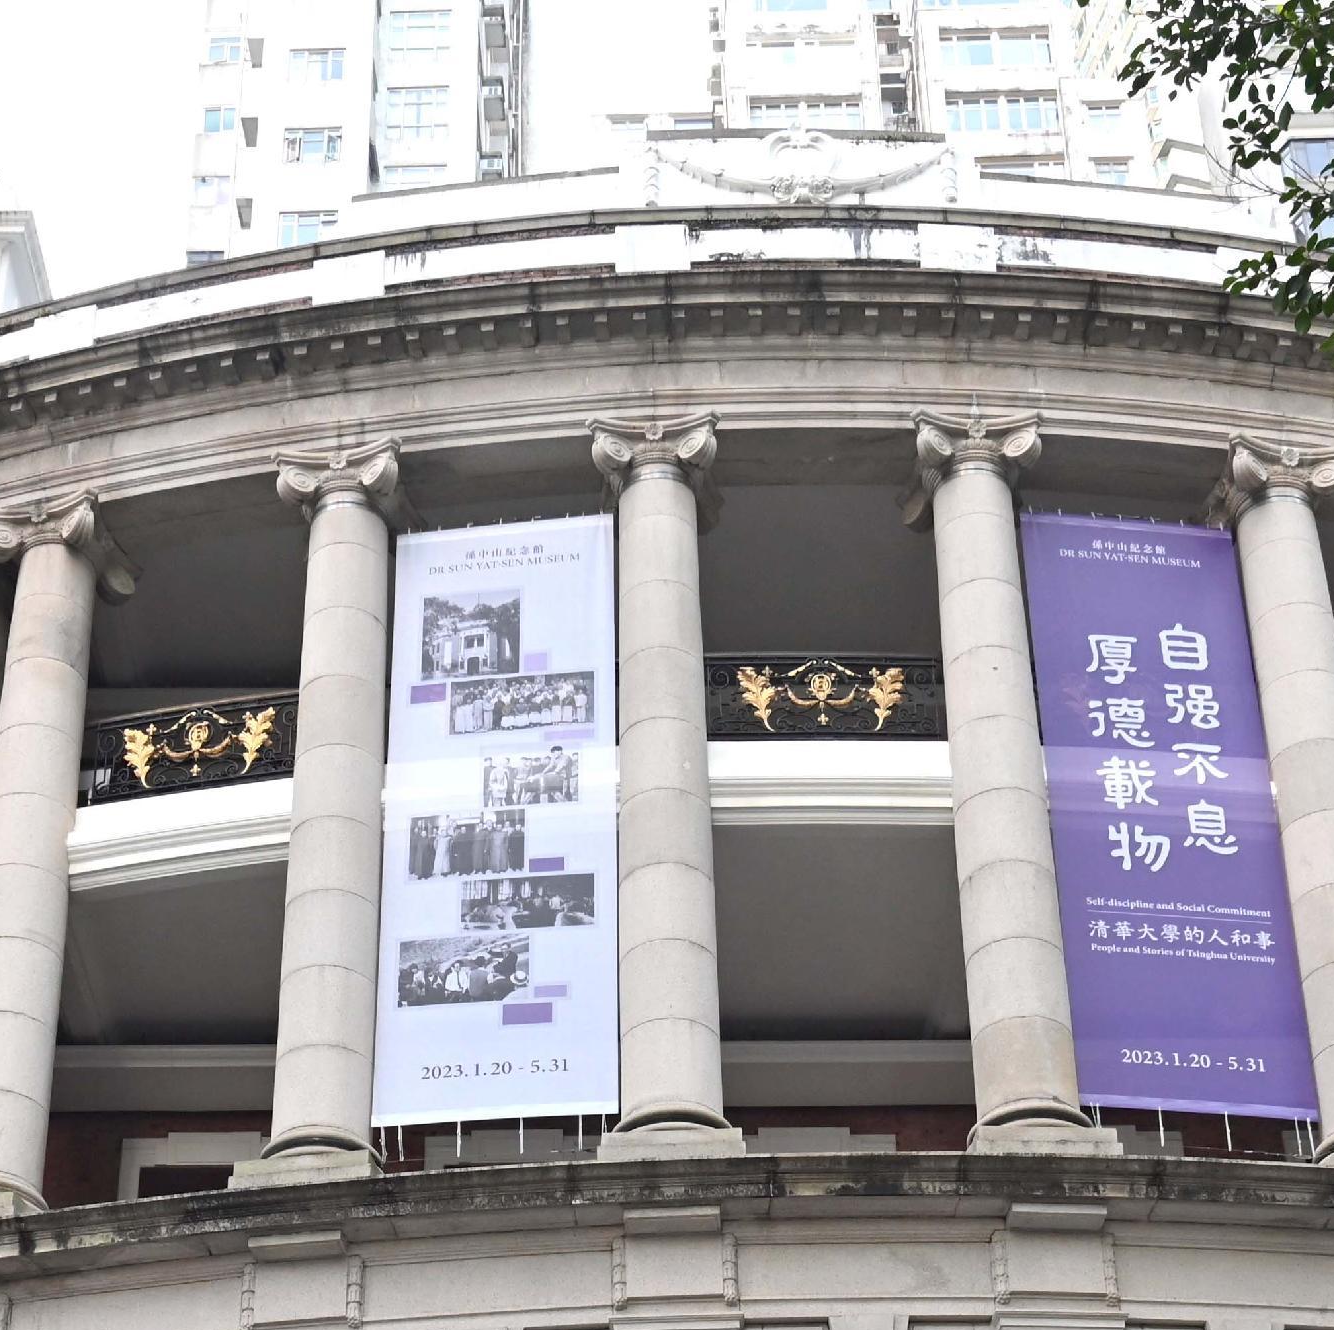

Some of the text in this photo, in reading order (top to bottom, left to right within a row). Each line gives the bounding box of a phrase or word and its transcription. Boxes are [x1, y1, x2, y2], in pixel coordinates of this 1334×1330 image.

[429, 552, 580, 575] DR SUN YAT-SEN MUSEUM
[1059, 548, 1201, 568] DR SUN YAT-SEN MUSEUM
[1086, 897, 1271, 918] Self-discipline and Social Commitment
[1088, 920, 1275, 950] 清華大學的人和事
[1091, 943, 1276, 966] People and Stories of Tsinghua University
[530, 1058, 569, 1073] 5.31
[1228, 1056, 1266, 1072] 5.31
